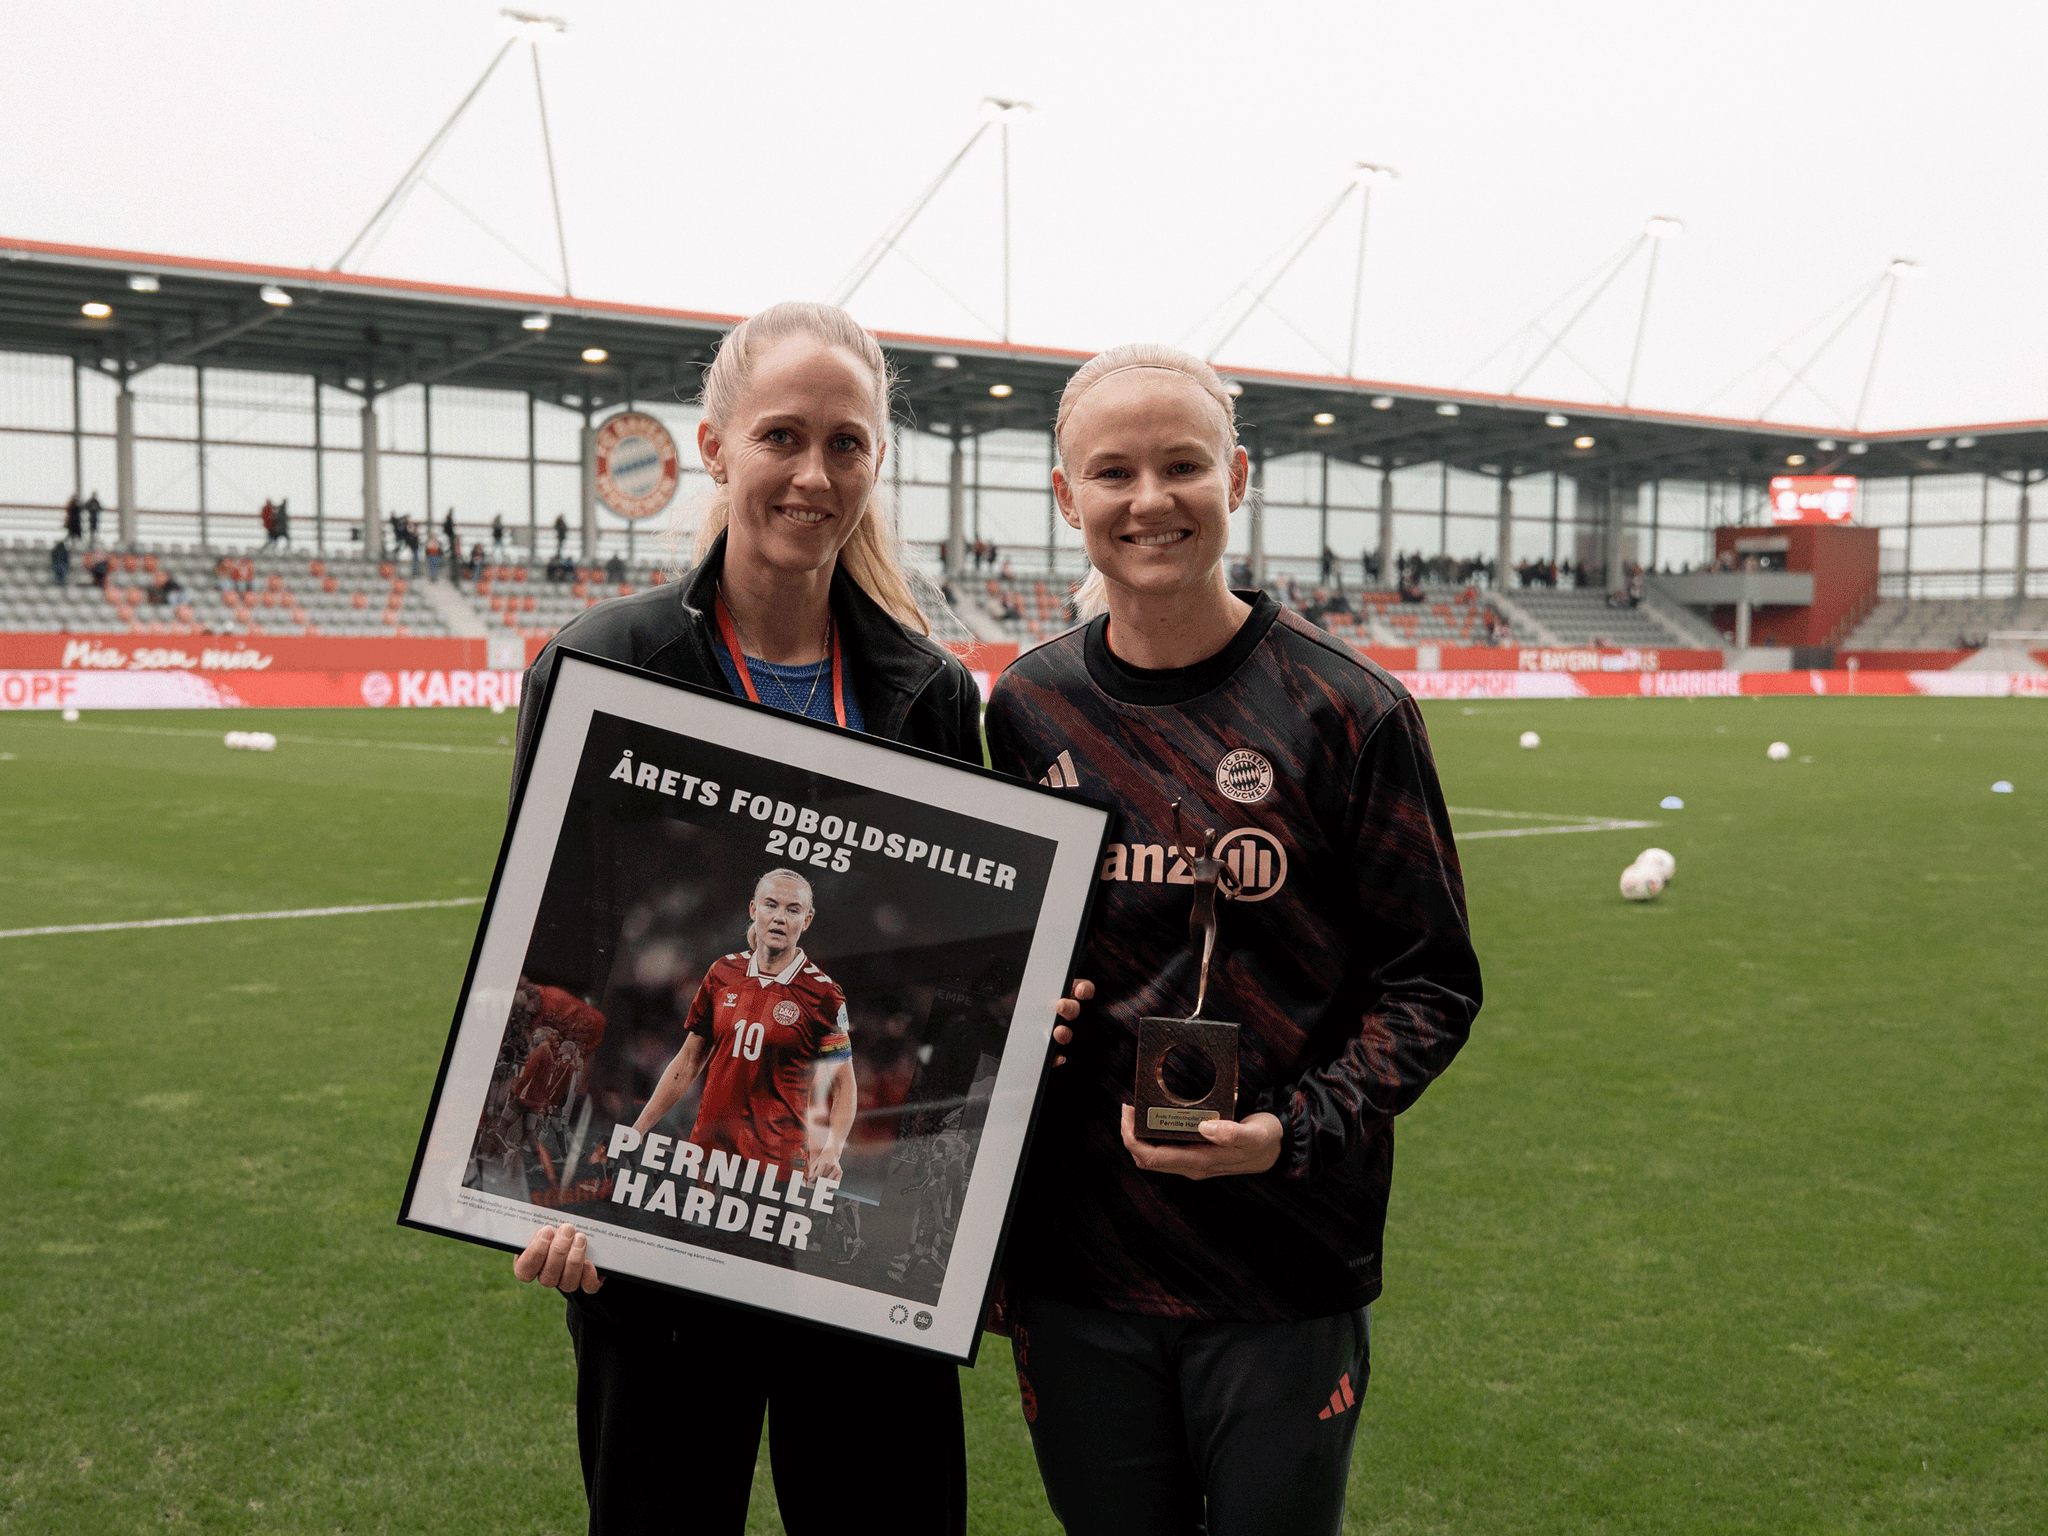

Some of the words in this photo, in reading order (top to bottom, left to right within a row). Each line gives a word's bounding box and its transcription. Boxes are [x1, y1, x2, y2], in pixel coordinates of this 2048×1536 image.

[62, 639, 128, 669] Mia
[127, 647, 199, 671] san
[201, 640, 274, 671] mia
[2, 674, 78, 708] OPF
[1221, 758, 1234, 772] FC
[1234, 752, 1269, 774] BAYERN
[609, 749, 721, 807] ÅRETS
[729, 789, 1018, 891] FODBOLDSPILLER
[765, 829, 852, 874] 2025
[1100, 842, 1196, 885] anz
[732, 1019, 765, 1062] 10
[1160, 1119, 1184, 1127] Pernille
[606, 1123, 841, 1215] PERNILLE
[611, 1168, 813, 1250] HARDER
